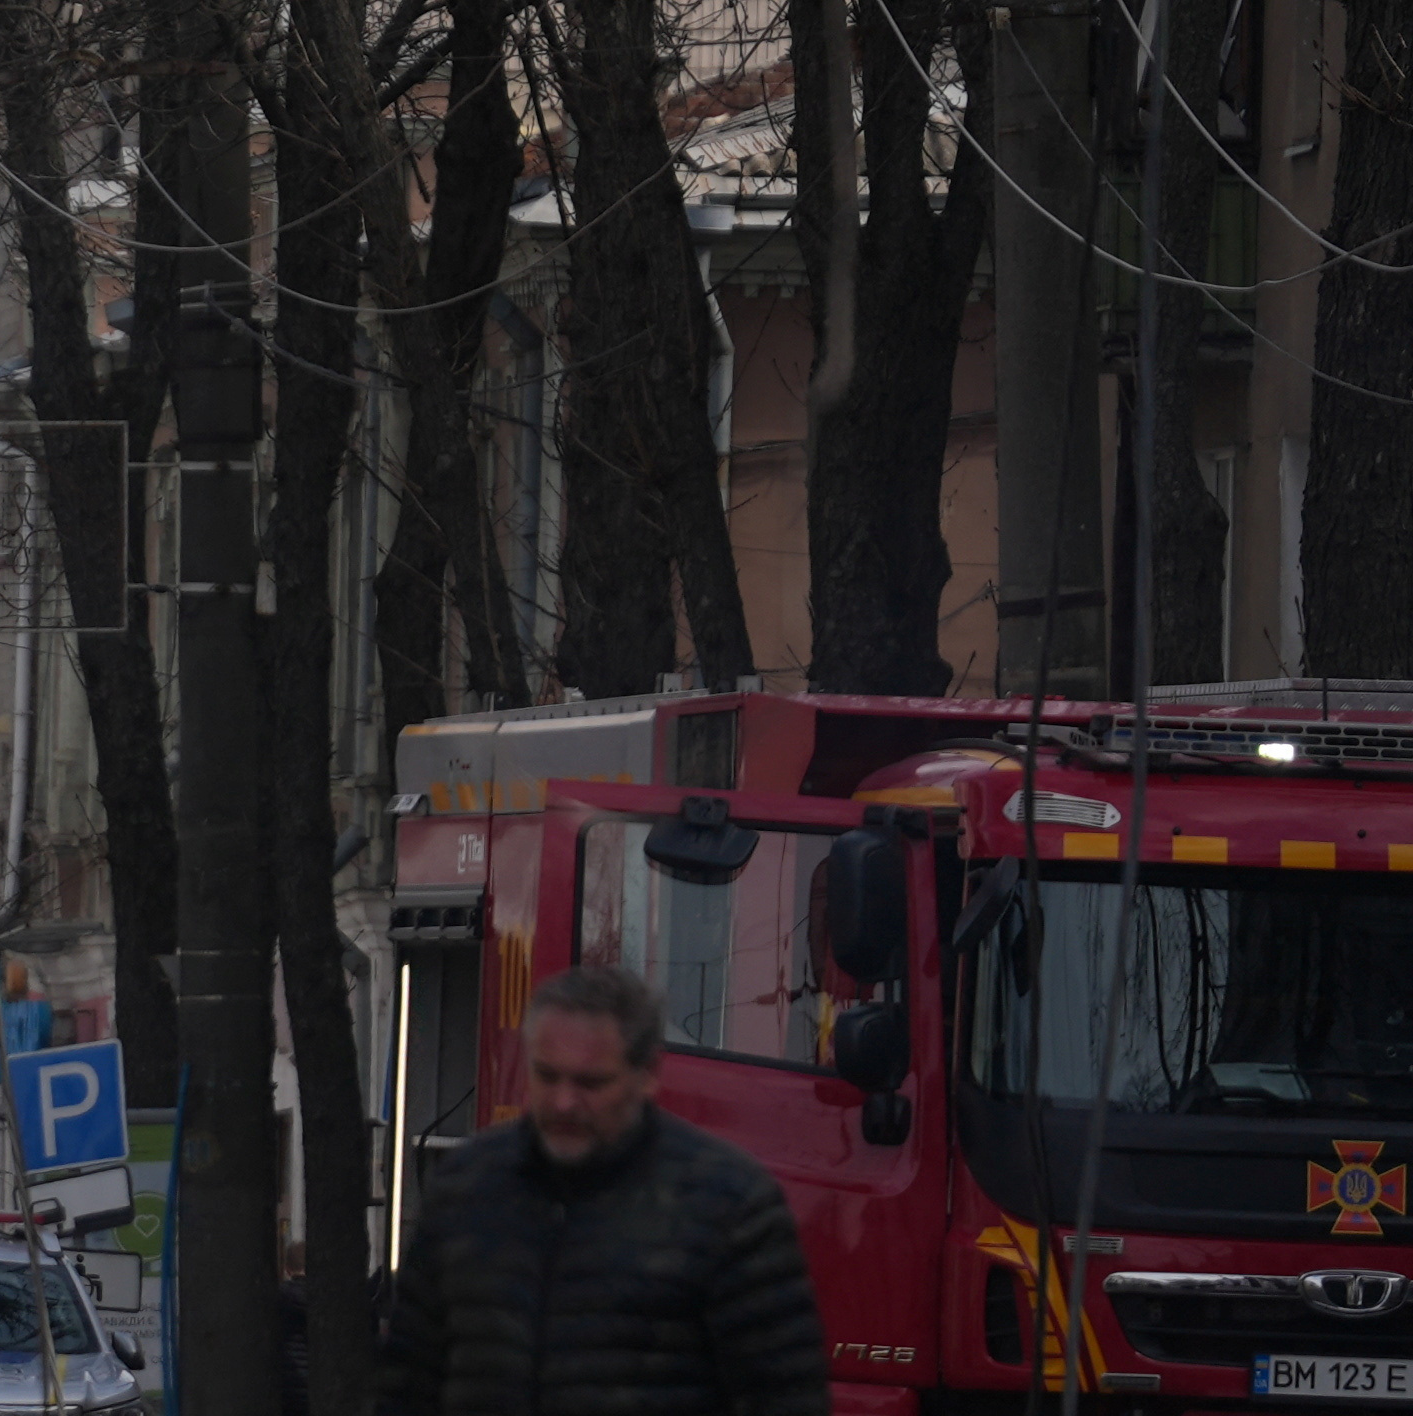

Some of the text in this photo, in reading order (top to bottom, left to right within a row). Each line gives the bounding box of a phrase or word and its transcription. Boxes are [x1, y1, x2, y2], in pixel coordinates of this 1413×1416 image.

[39, 1061, 100, 1158] P
[100, 1316, 145, 1326] АВЖДИ
[832, 1342, 917, 1362] 1728
[1273, 1360, 1317, 1389] BM
[1329, 1362, 1376, 1391] 123
